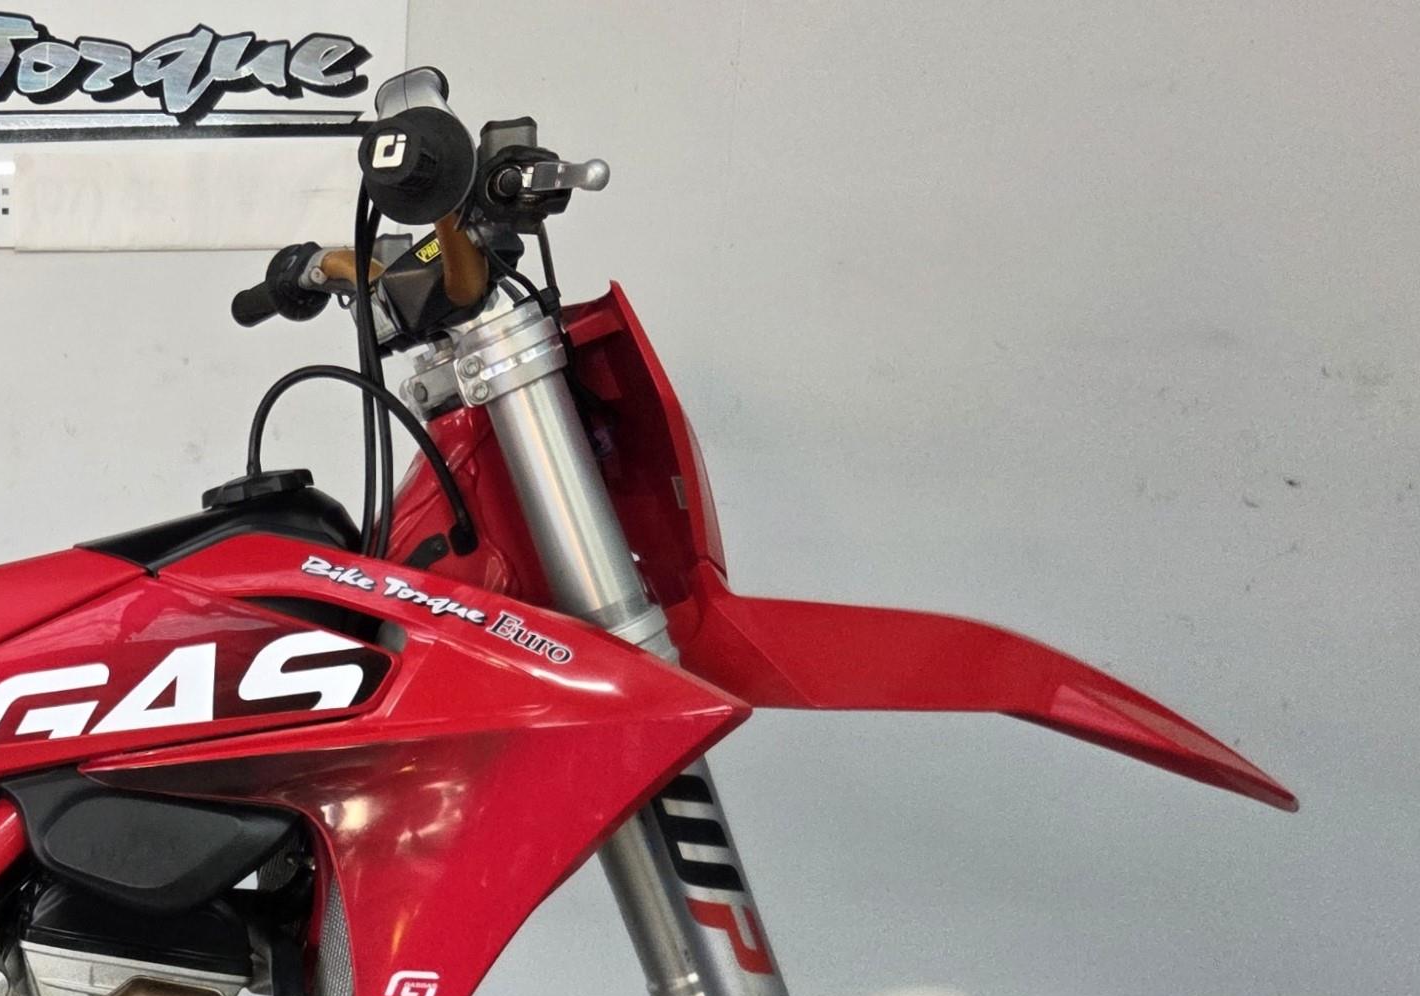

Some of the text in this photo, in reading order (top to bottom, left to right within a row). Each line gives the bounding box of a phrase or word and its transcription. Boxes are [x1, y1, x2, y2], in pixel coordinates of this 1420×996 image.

[300, 555, 573, 665] Bike Torque Euro
